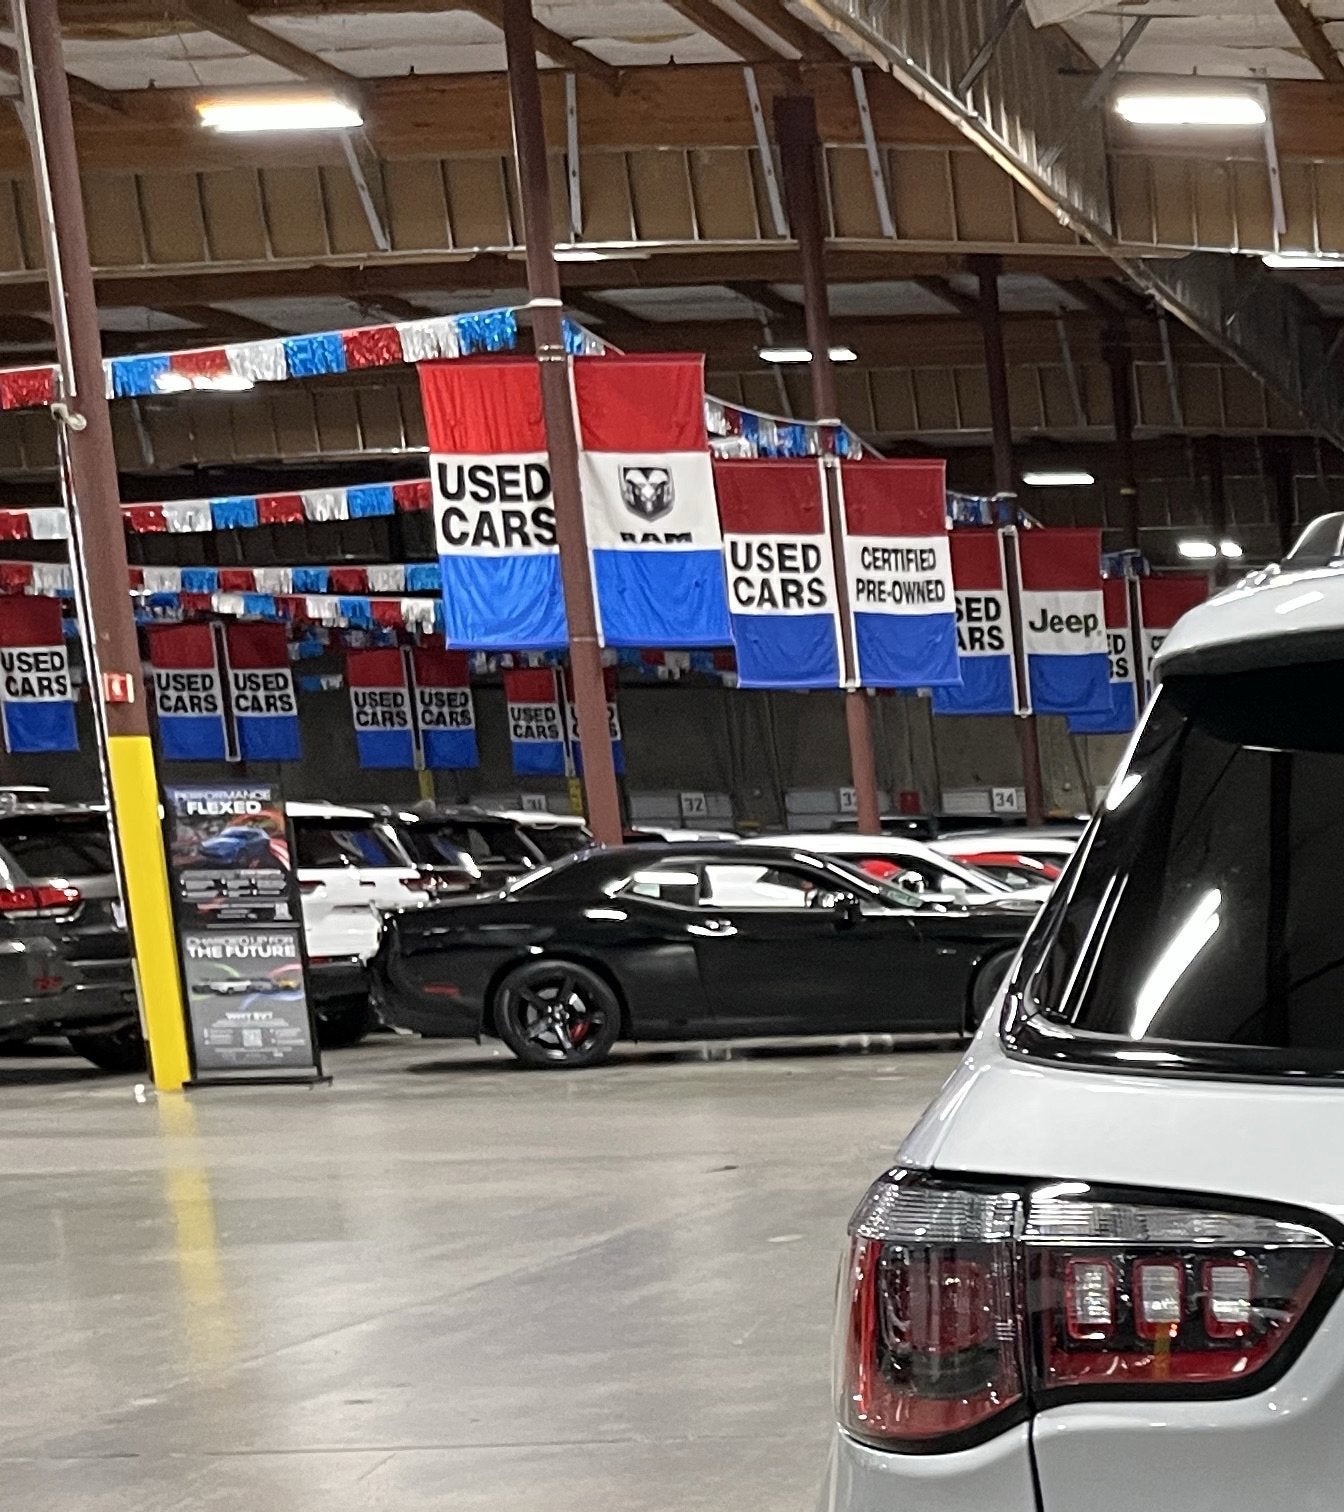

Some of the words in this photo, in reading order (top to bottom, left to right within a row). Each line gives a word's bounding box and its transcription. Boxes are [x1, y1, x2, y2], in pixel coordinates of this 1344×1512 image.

[437, 462, 551, 504] USED
[441, 506, 557, 548] CARS
[619, 531, 693, 543] RAM
[730, 541, 822, 574] USED
[860, 546, 937, 572] CERTIFIED
[733, 576, 828, 609] CARS
[856, 578, 946, 605] PRE-OWNED
[1029, 608, 1099, 638] Jeep
[1, 651, 65, 673] USED
[5, 675, 68, 697] CARS
[156, 673, 214, 692] USED
[234, 673, 289, 692] USED
[159, 694, 218, 713] CARS
[235, 694, 294, 713] CARS
[354, 691, 405, 708] USED
[420, 691, 469, 708] USED
[356, 710, 408, 727] CARS
[421, 709, 472, 727] CARS
[510, 707, 556, 722] USED
[513, 724, 559, 739] CARS
[995, 792, 1015, 807] 34
